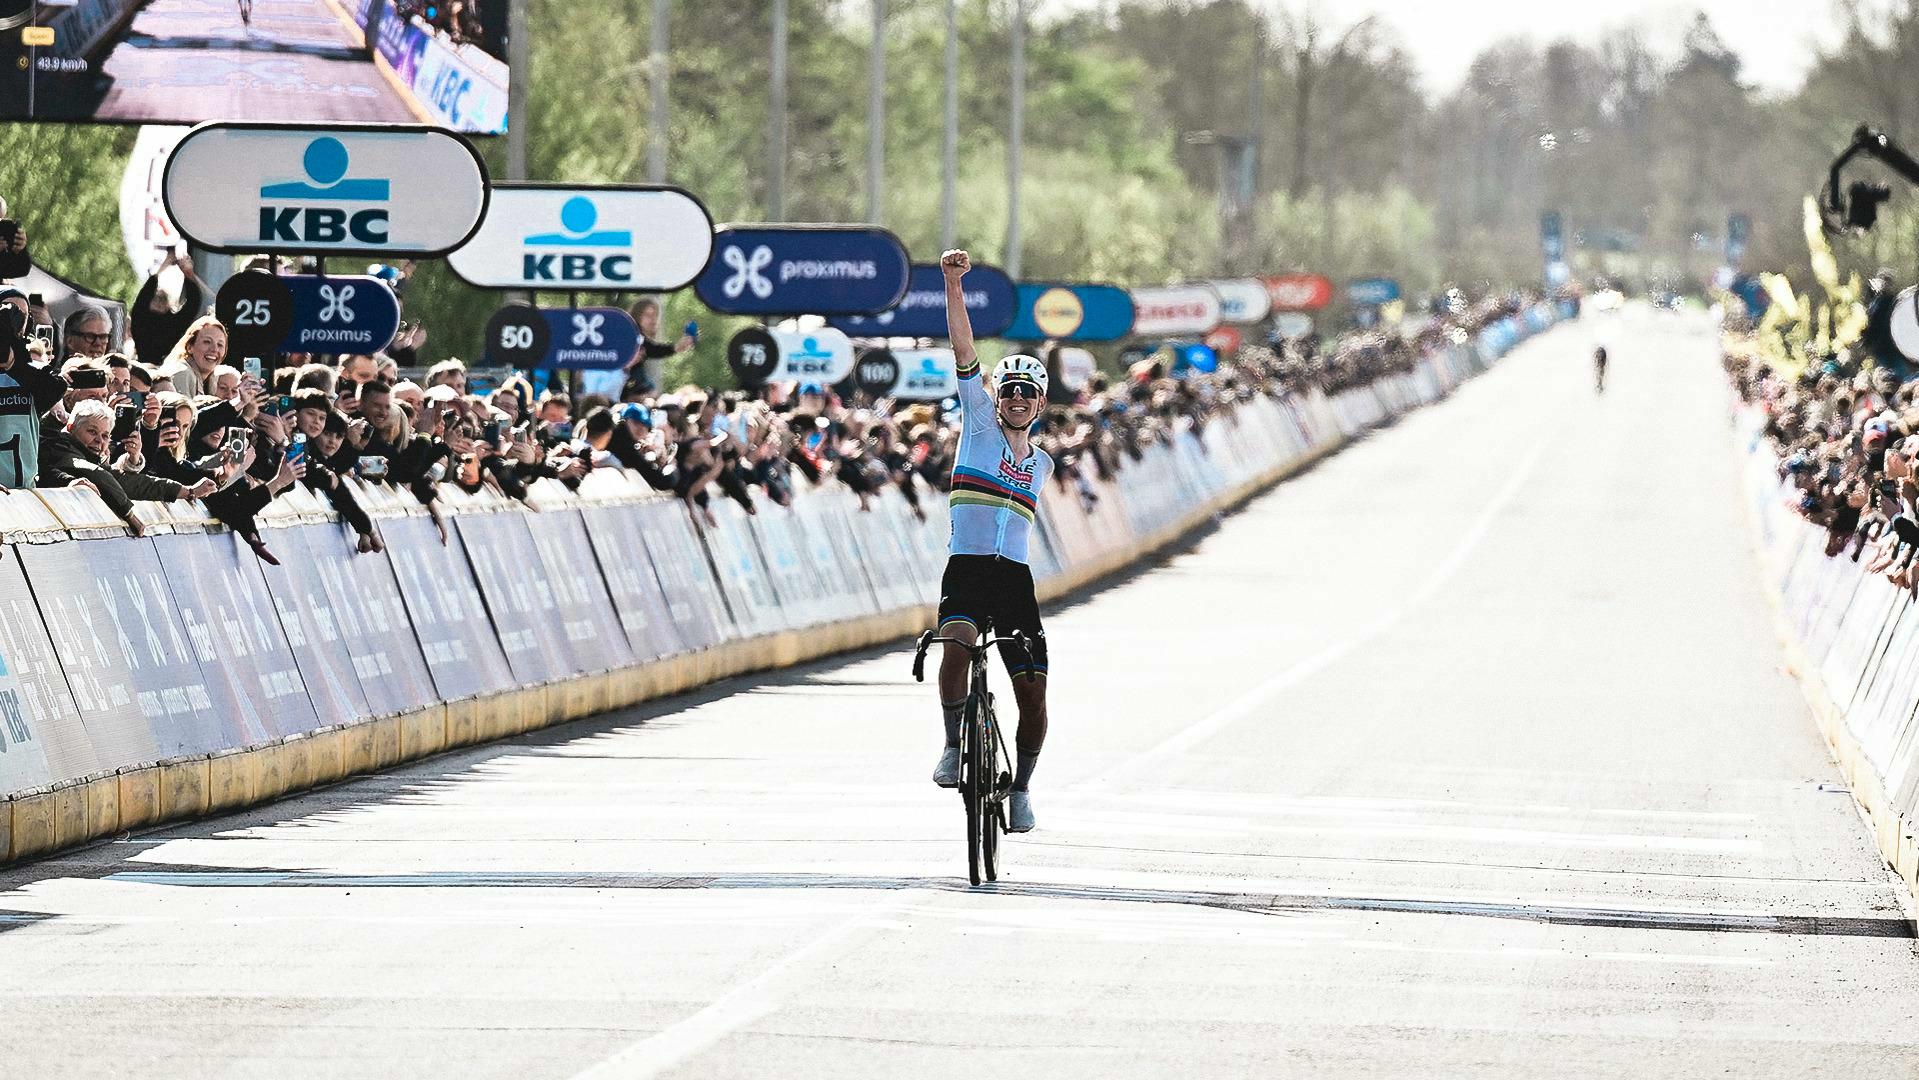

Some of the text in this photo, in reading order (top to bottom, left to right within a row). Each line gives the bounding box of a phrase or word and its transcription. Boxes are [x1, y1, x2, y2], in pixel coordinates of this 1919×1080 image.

[259, 206, 389, 244] KBC
[523, 254, 632, 281] KBC
[780, 260, 877, 284] proximus
[235, 299, 271, 326] 25
[301, 328, 372, 343] proximus
[501, 325, 534, 348] 50
[557, 349, 619, 363] proximus
[741, 343, 767, 366] 75
[860, 362, 894, 384] 100
[997, 470, 1031, 490] XRG
